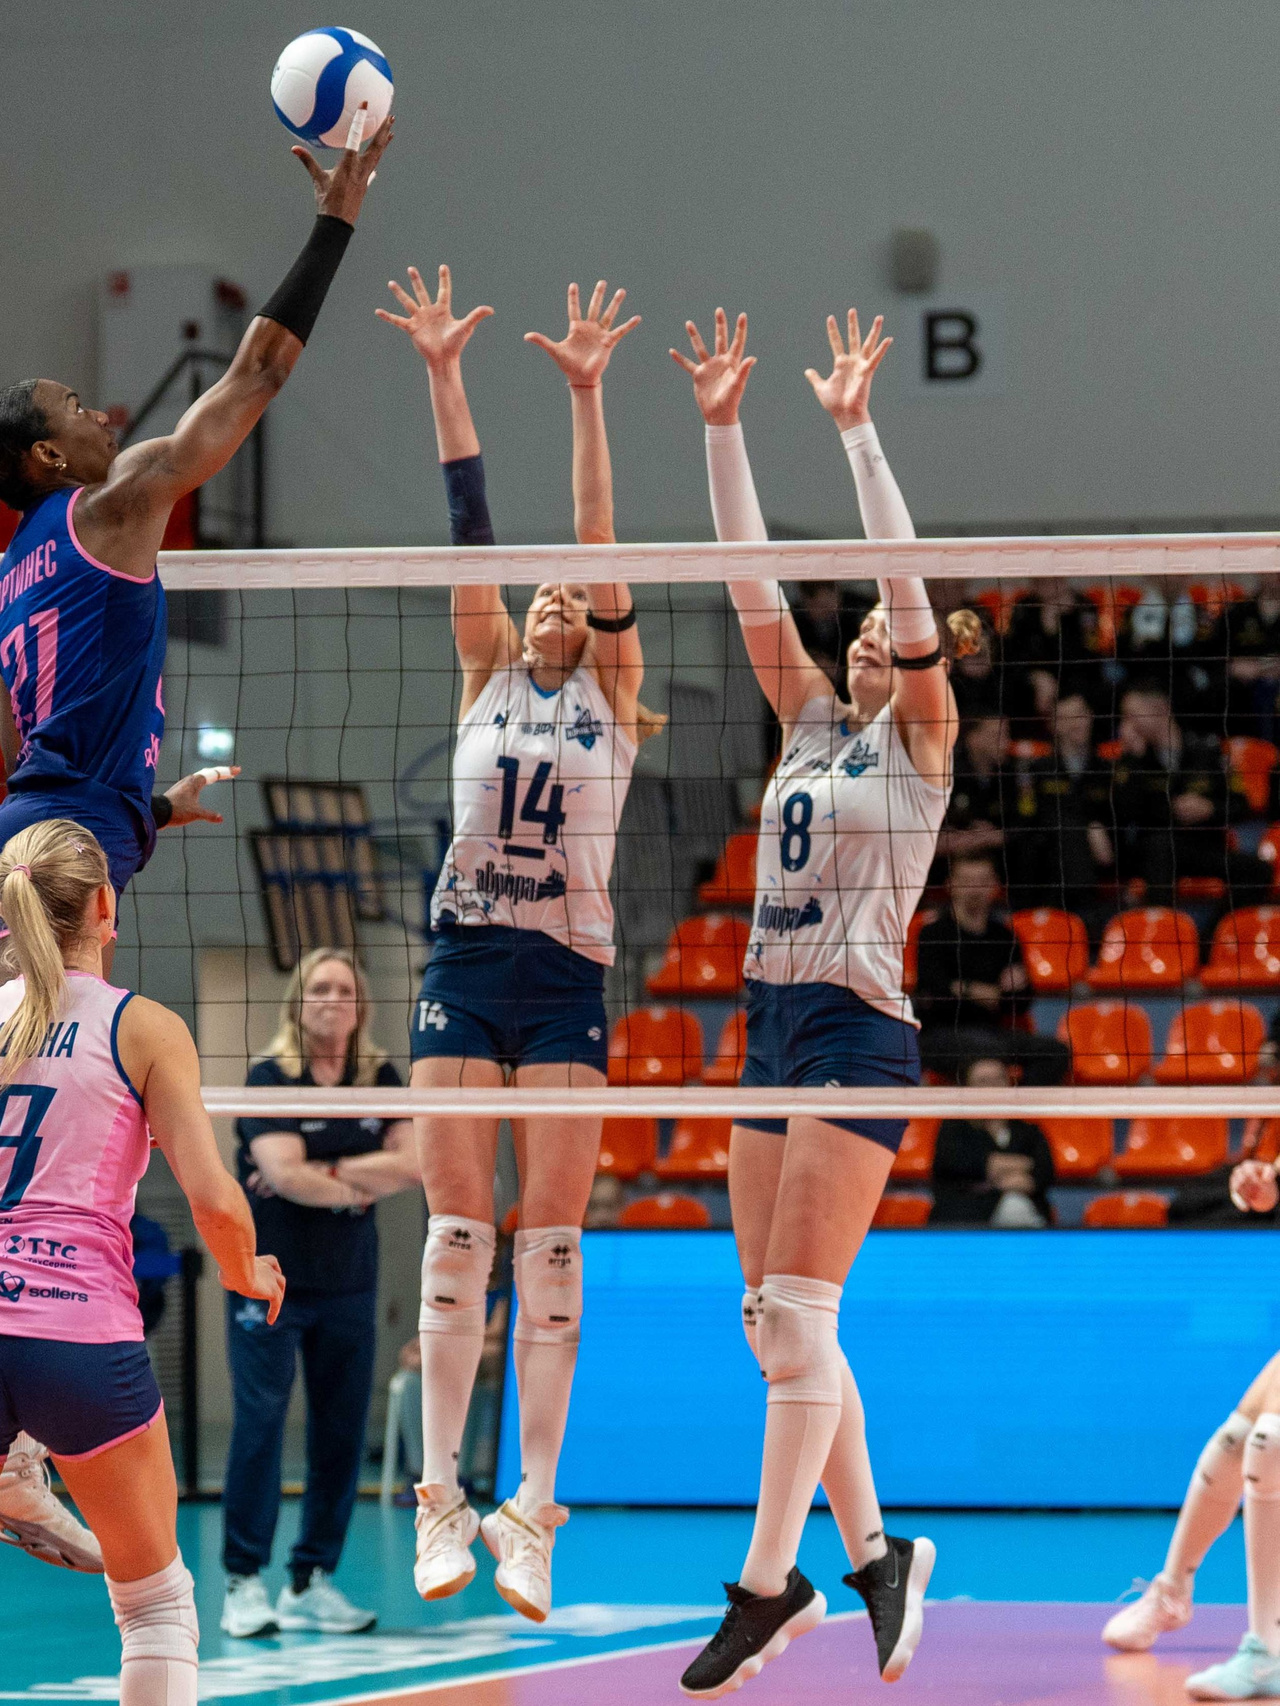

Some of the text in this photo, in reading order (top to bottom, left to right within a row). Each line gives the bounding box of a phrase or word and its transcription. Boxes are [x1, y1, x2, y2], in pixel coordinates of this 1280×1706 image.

[496, 755, 566, 845] 14
[781, 792, 813, 873] 8
[418, 1000, 449, 1032] 14
[28, 1287, 89, 1303] sollers
